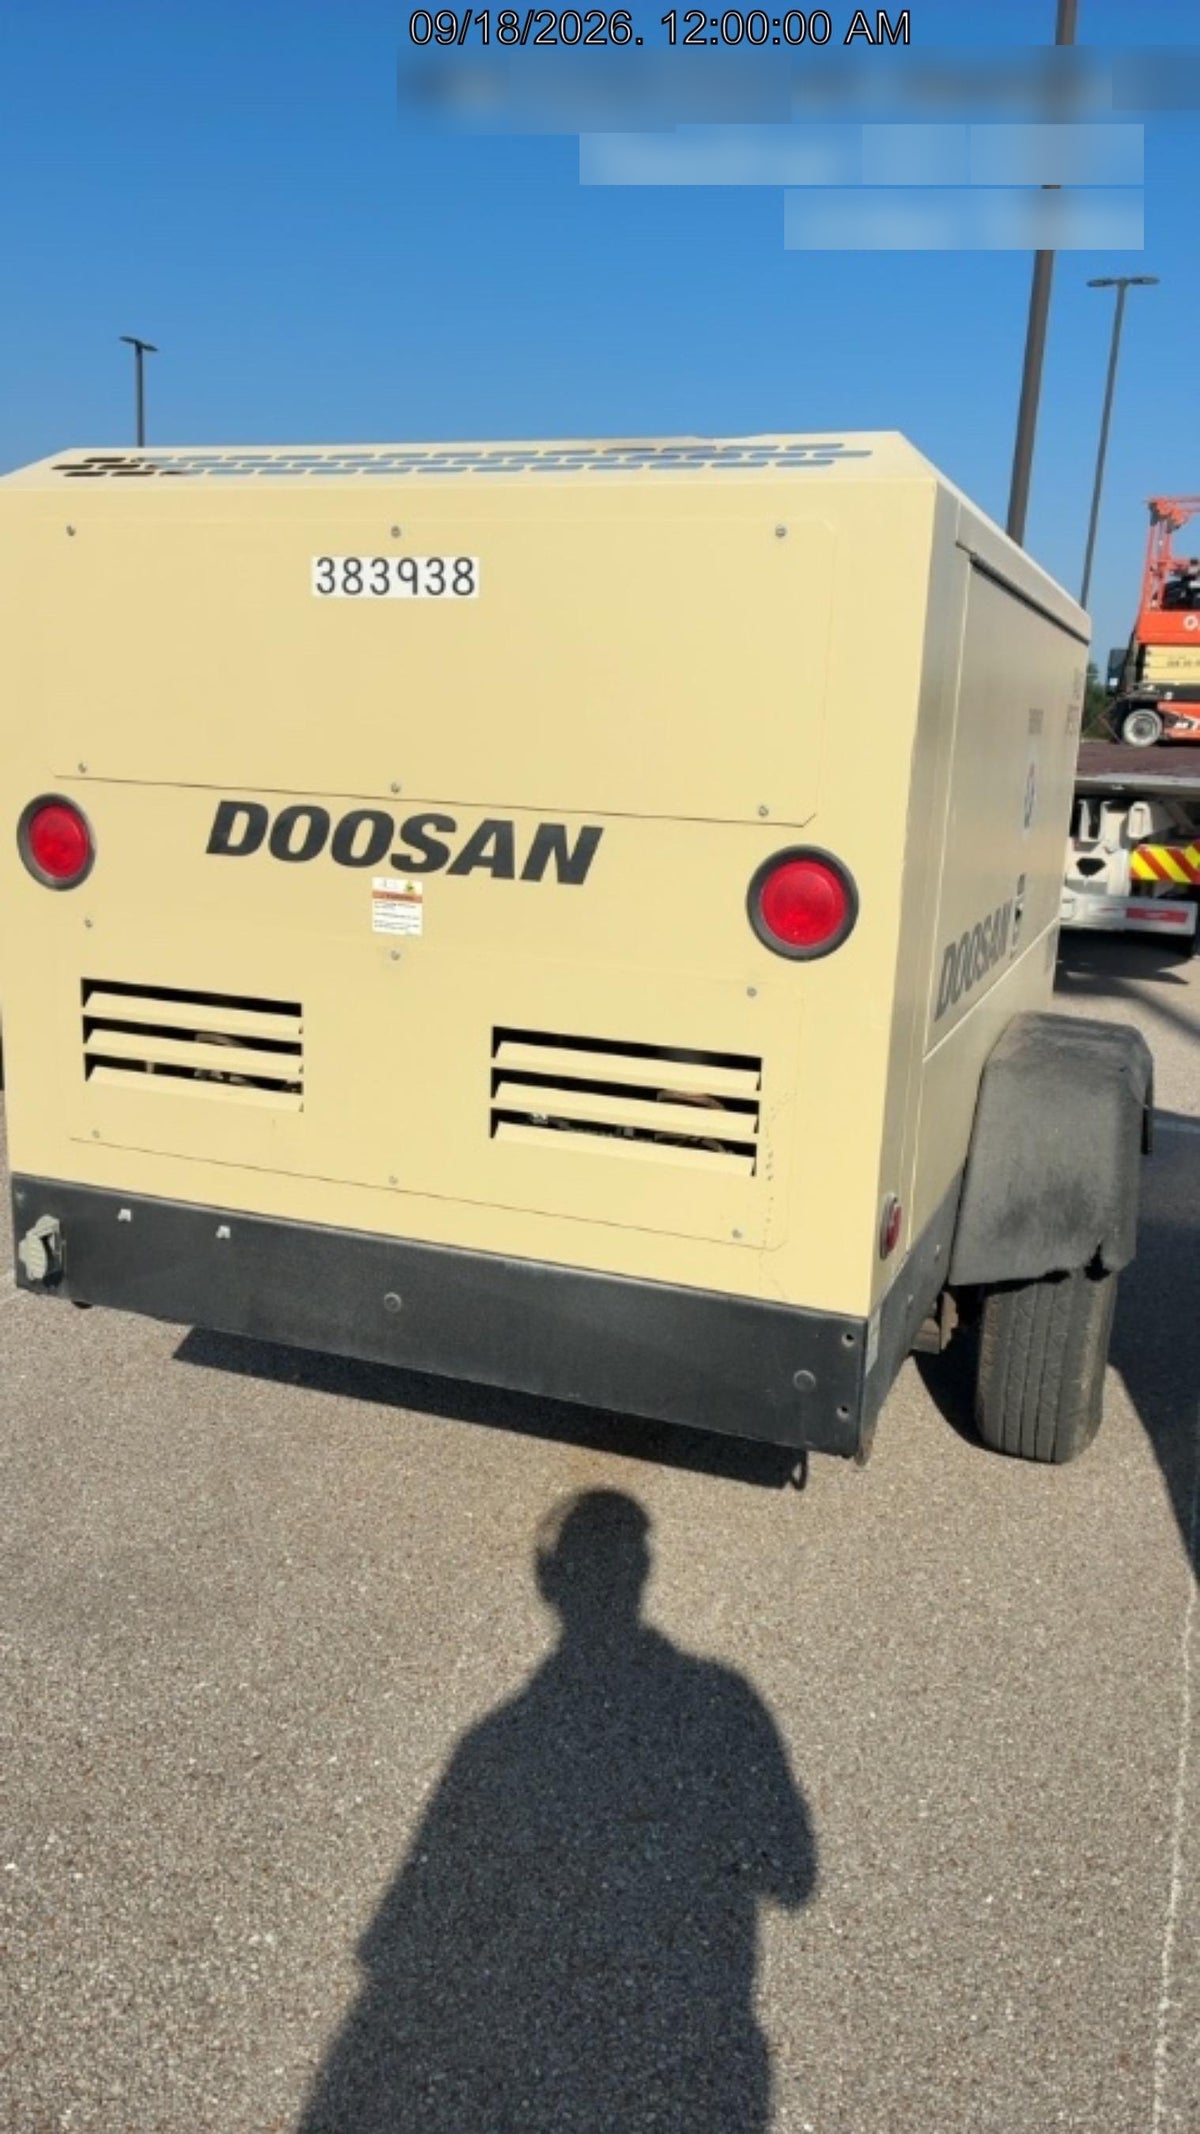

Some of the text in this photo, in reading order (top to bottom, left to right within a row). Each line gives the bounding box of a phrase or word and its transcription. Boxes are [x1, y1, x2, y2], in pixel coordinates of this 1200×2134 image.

[316, 557, 475, 596] 383938
[206, 800, 603, 885] DOOSAN
[934, 898, 1013, 1022] DOOSAN
